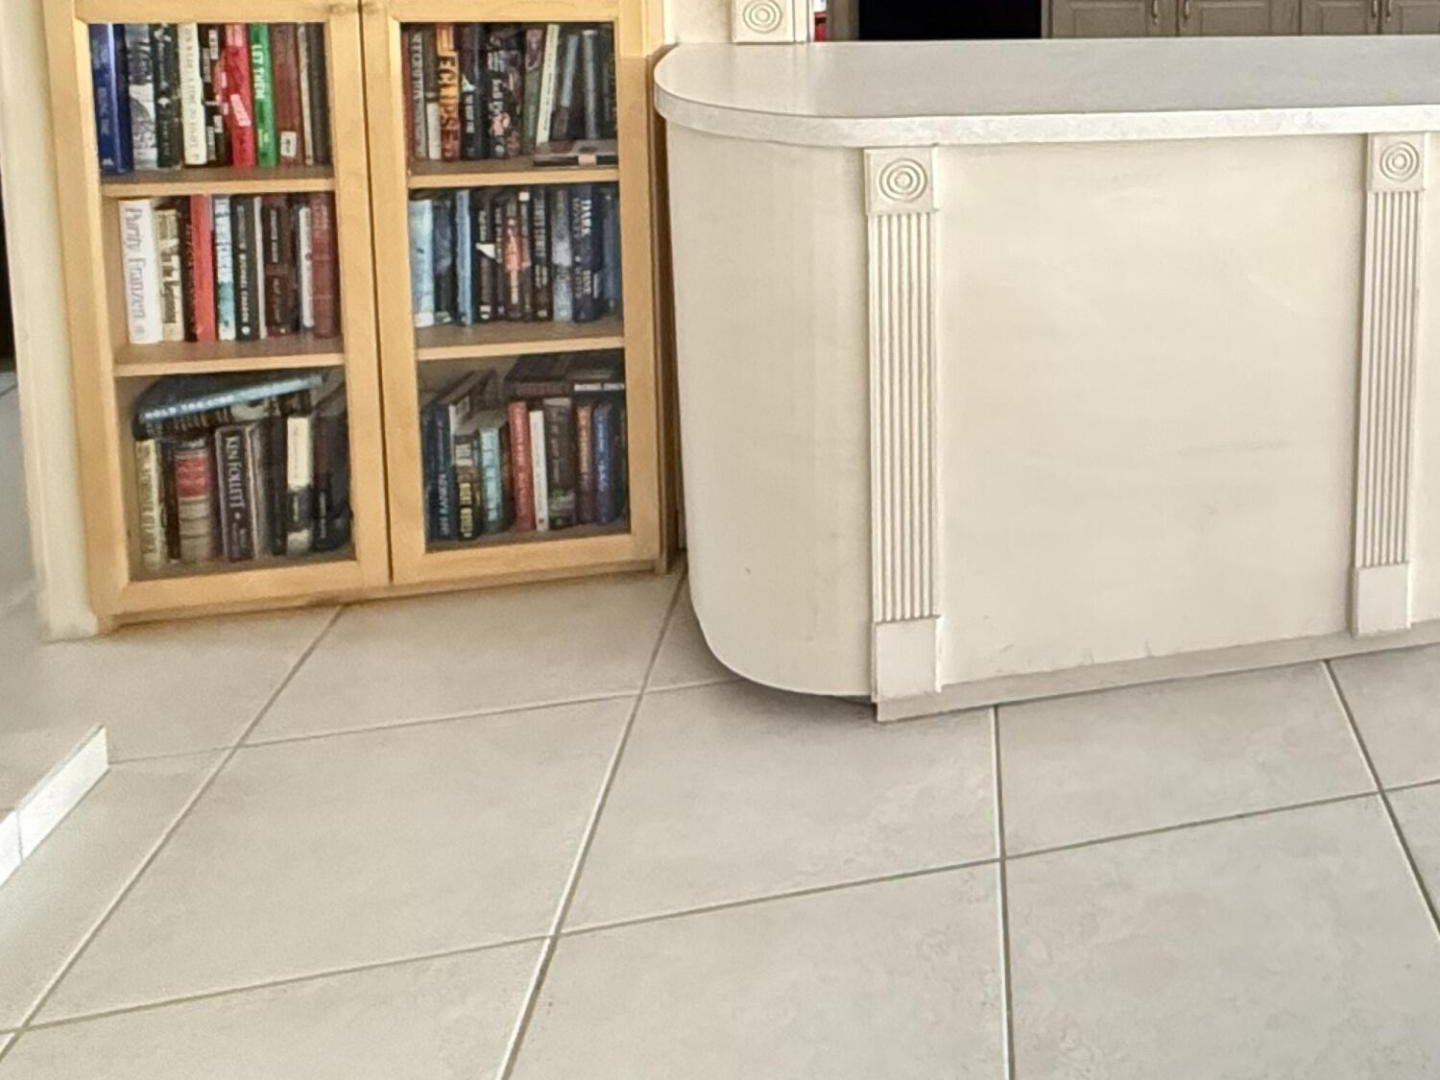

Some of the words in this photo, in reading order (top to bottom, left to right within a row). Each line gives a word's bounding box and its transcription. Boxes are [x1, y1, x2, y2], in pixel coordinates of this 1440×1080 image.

[251, 44, 264, 64] LET
[438, 56, 458, 144] ECLIPSE
[123, 207, 145, 252] Purity
[127, 258, 148, 320] Franzen
[225, 436, 241, 460] KEN
[228, 462, 245, 508] FOLLETT
